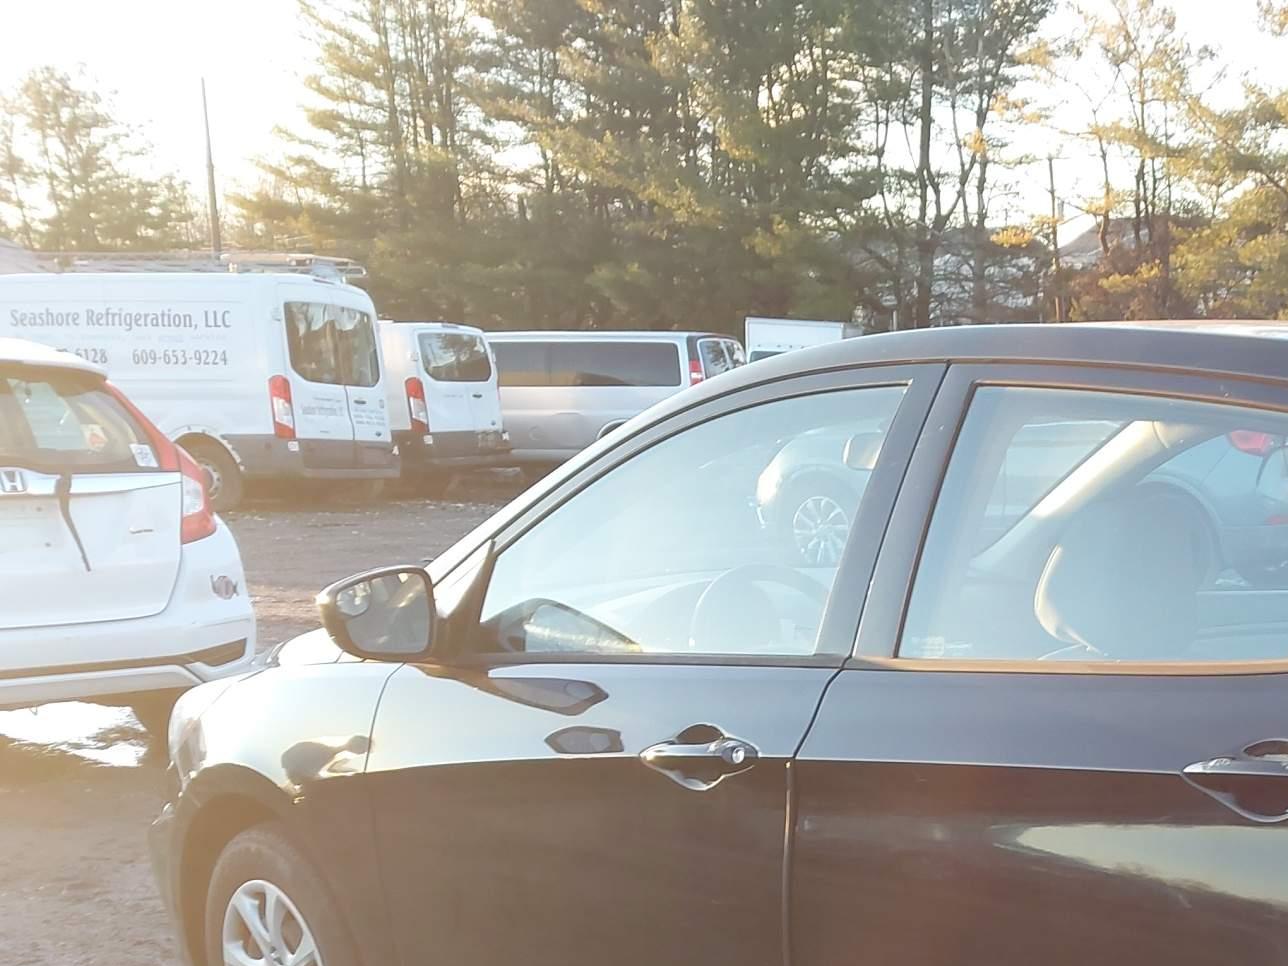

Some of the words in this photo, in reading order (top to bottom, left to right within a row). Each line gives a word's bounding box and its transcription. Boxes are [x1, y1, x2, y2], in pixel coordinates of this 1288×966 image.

[10, 308, 80, 327] Seashore
[86, 308, 198, 331] Refrigeration,
[204, 310, 231, 328] LLC
[132, 349, 228, 366] 609-653-9224
